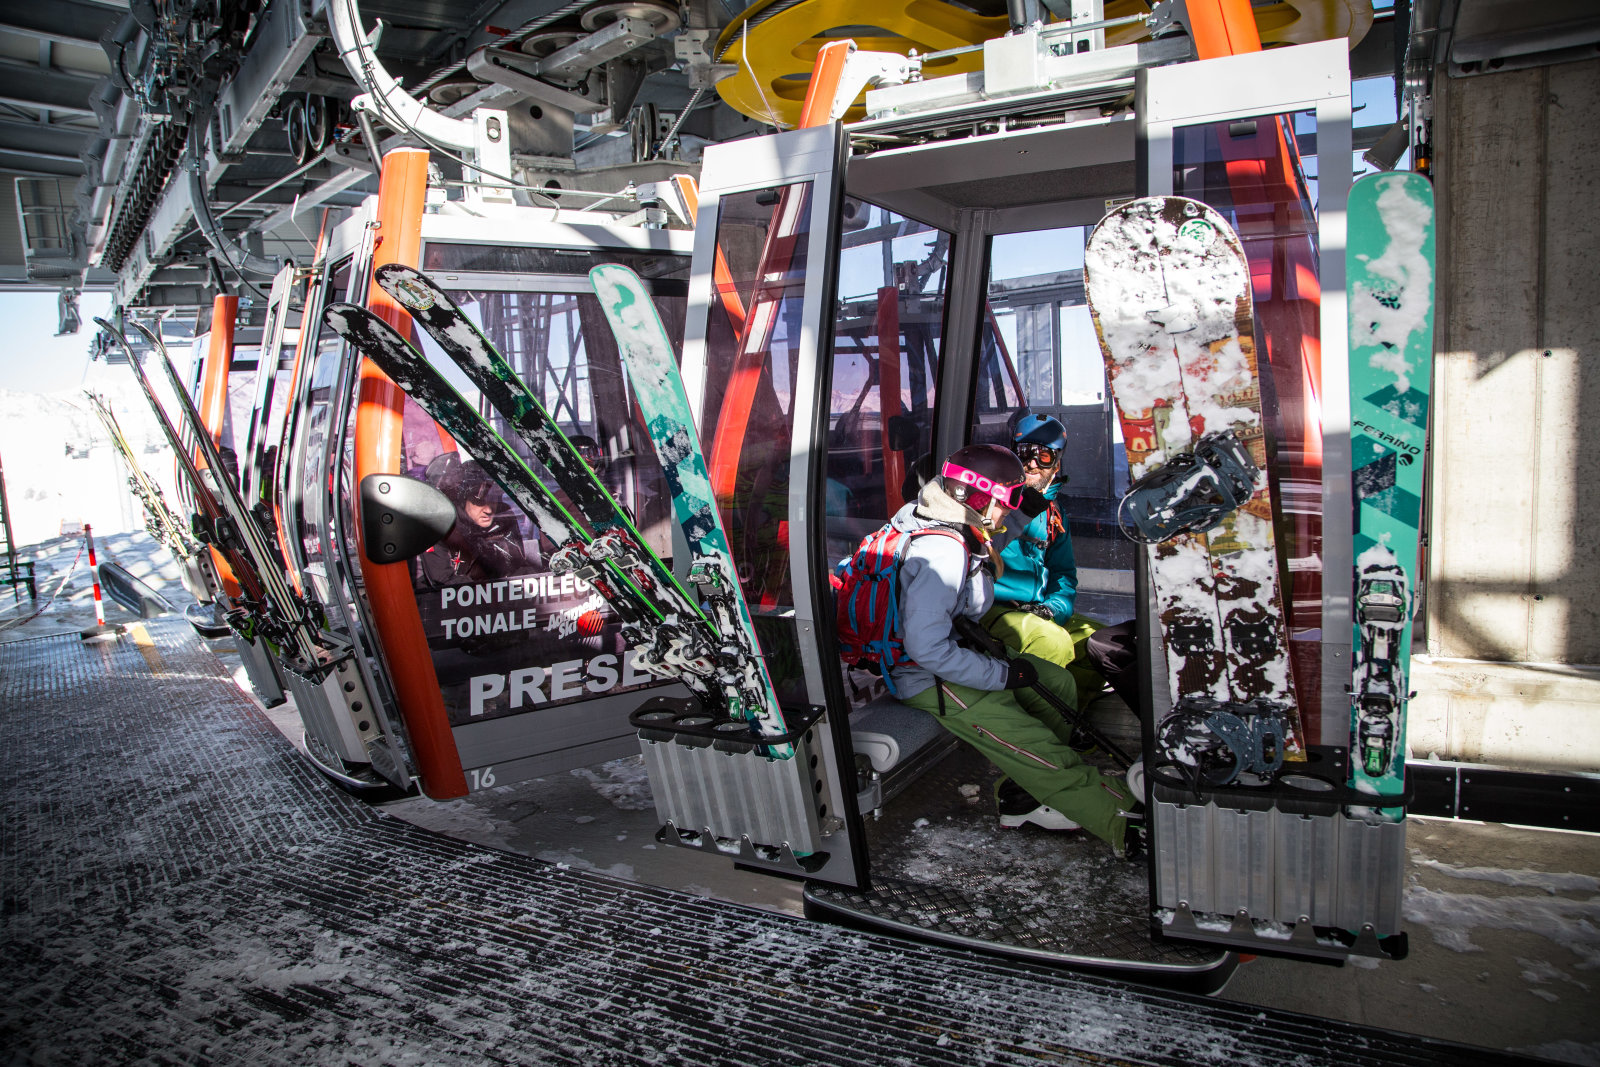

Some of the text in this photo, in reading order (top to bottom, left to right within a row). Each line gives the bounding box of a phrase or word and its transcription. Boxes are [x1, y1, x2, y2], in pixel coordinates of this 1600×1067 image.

[1353, 420, 1421, 455] FERRINO
[960, 469, 1006, 499] POC
[441, 572, 595, 609] PONTEDILEG
[441, 608, 537, 640] TONALE
[547, 593, 604, 632] Adamello
[558, 620, 577, 640] Ski
[471, 766, 496, 790] 16
